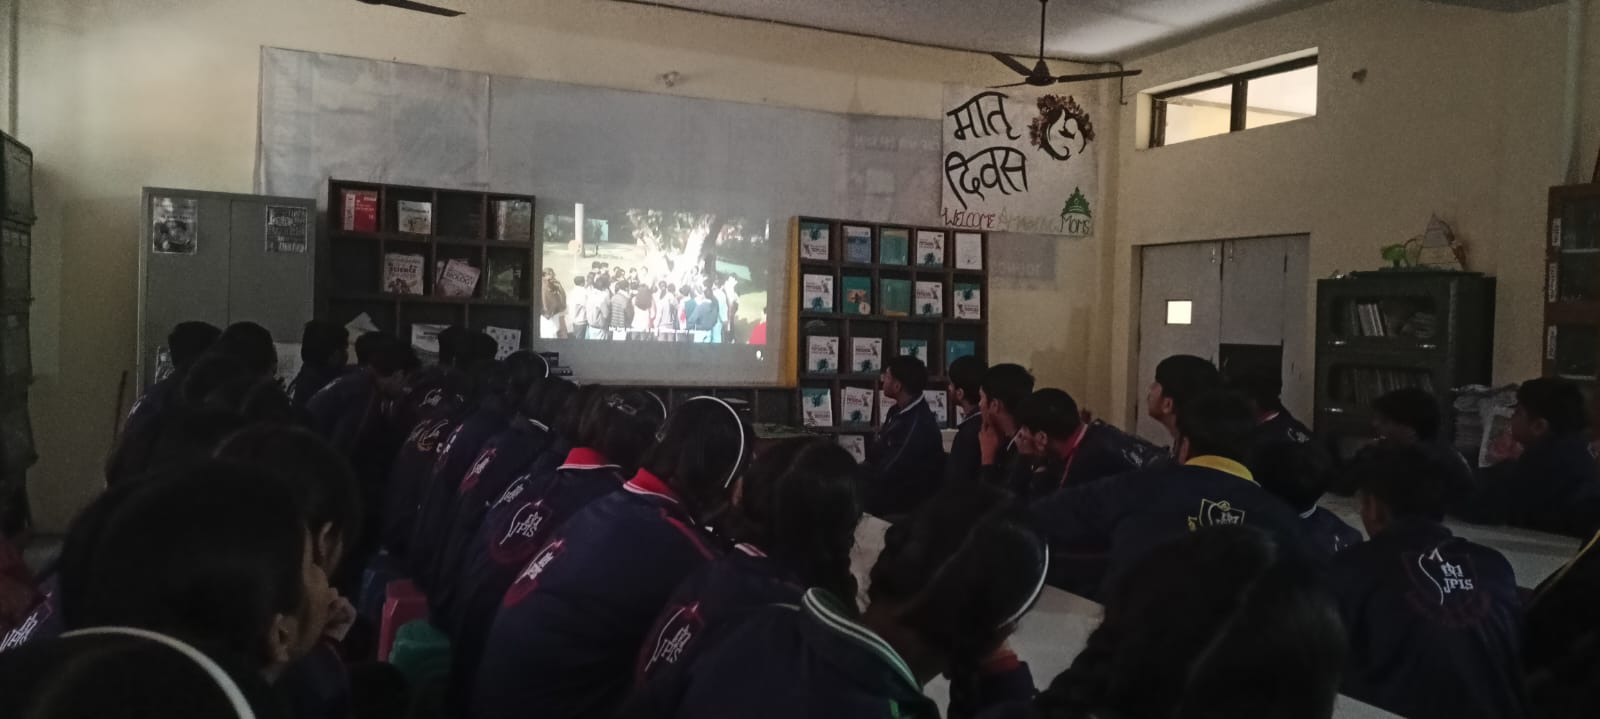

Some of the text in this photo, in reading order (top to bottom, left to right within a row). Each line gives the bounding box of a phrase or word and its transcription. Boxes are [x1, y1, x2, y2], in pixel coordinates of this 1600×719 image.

[945, 146, 1028, 210] दिवस
[941, 207, 996, 229] WELCOME
[1443, 577, 1474, 594] JPIS
